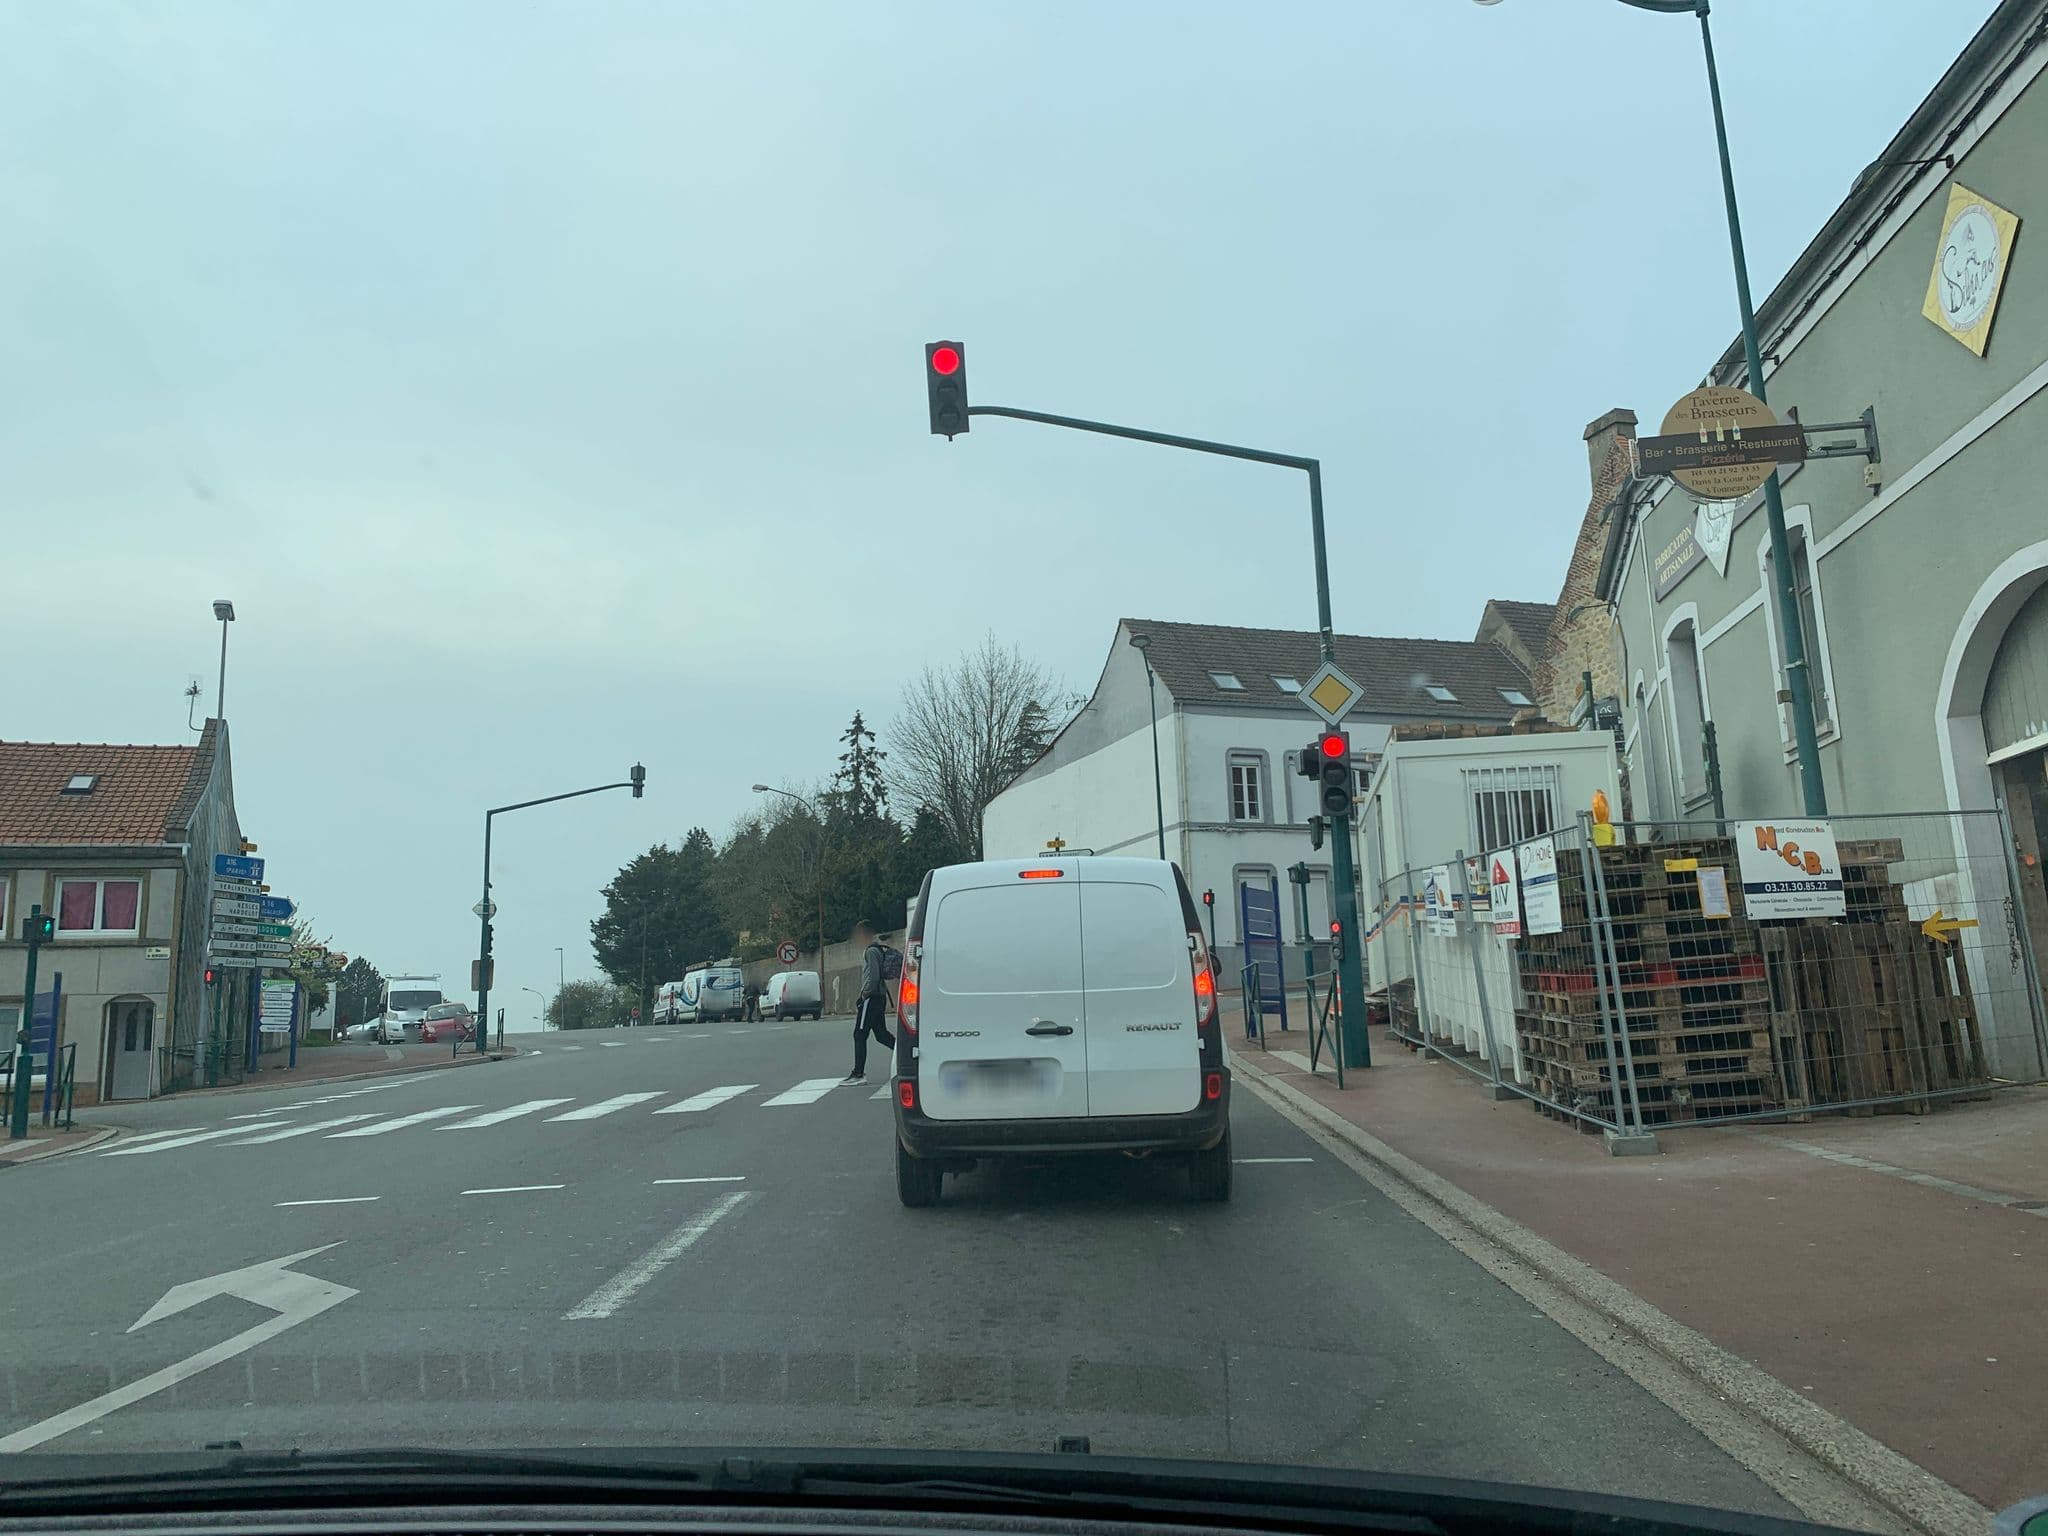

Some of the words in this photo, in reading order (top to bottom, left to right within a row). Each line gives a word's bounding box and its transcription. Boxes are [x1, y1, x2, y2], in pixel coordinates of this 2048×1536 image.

[1691, 395, 1740, 407] Taverne
[1691, 406, 1758, 420] Brasseurs
[1645, 448, 1664, 458] Bar
[1675, 443, 1728, 456] Brasserie
[1739, 436, 1800, 450] Restaurant
[1723, 476, 1744, 484] Cour
[1655, 524, 1692, 570] FABRICATION
[1660, 543, 1695, 584] ARTISANALE
[1764, 881, 1828, 892] 03.21.30.85.22
[1126, 1023, 1182, 1032] RENAULT
